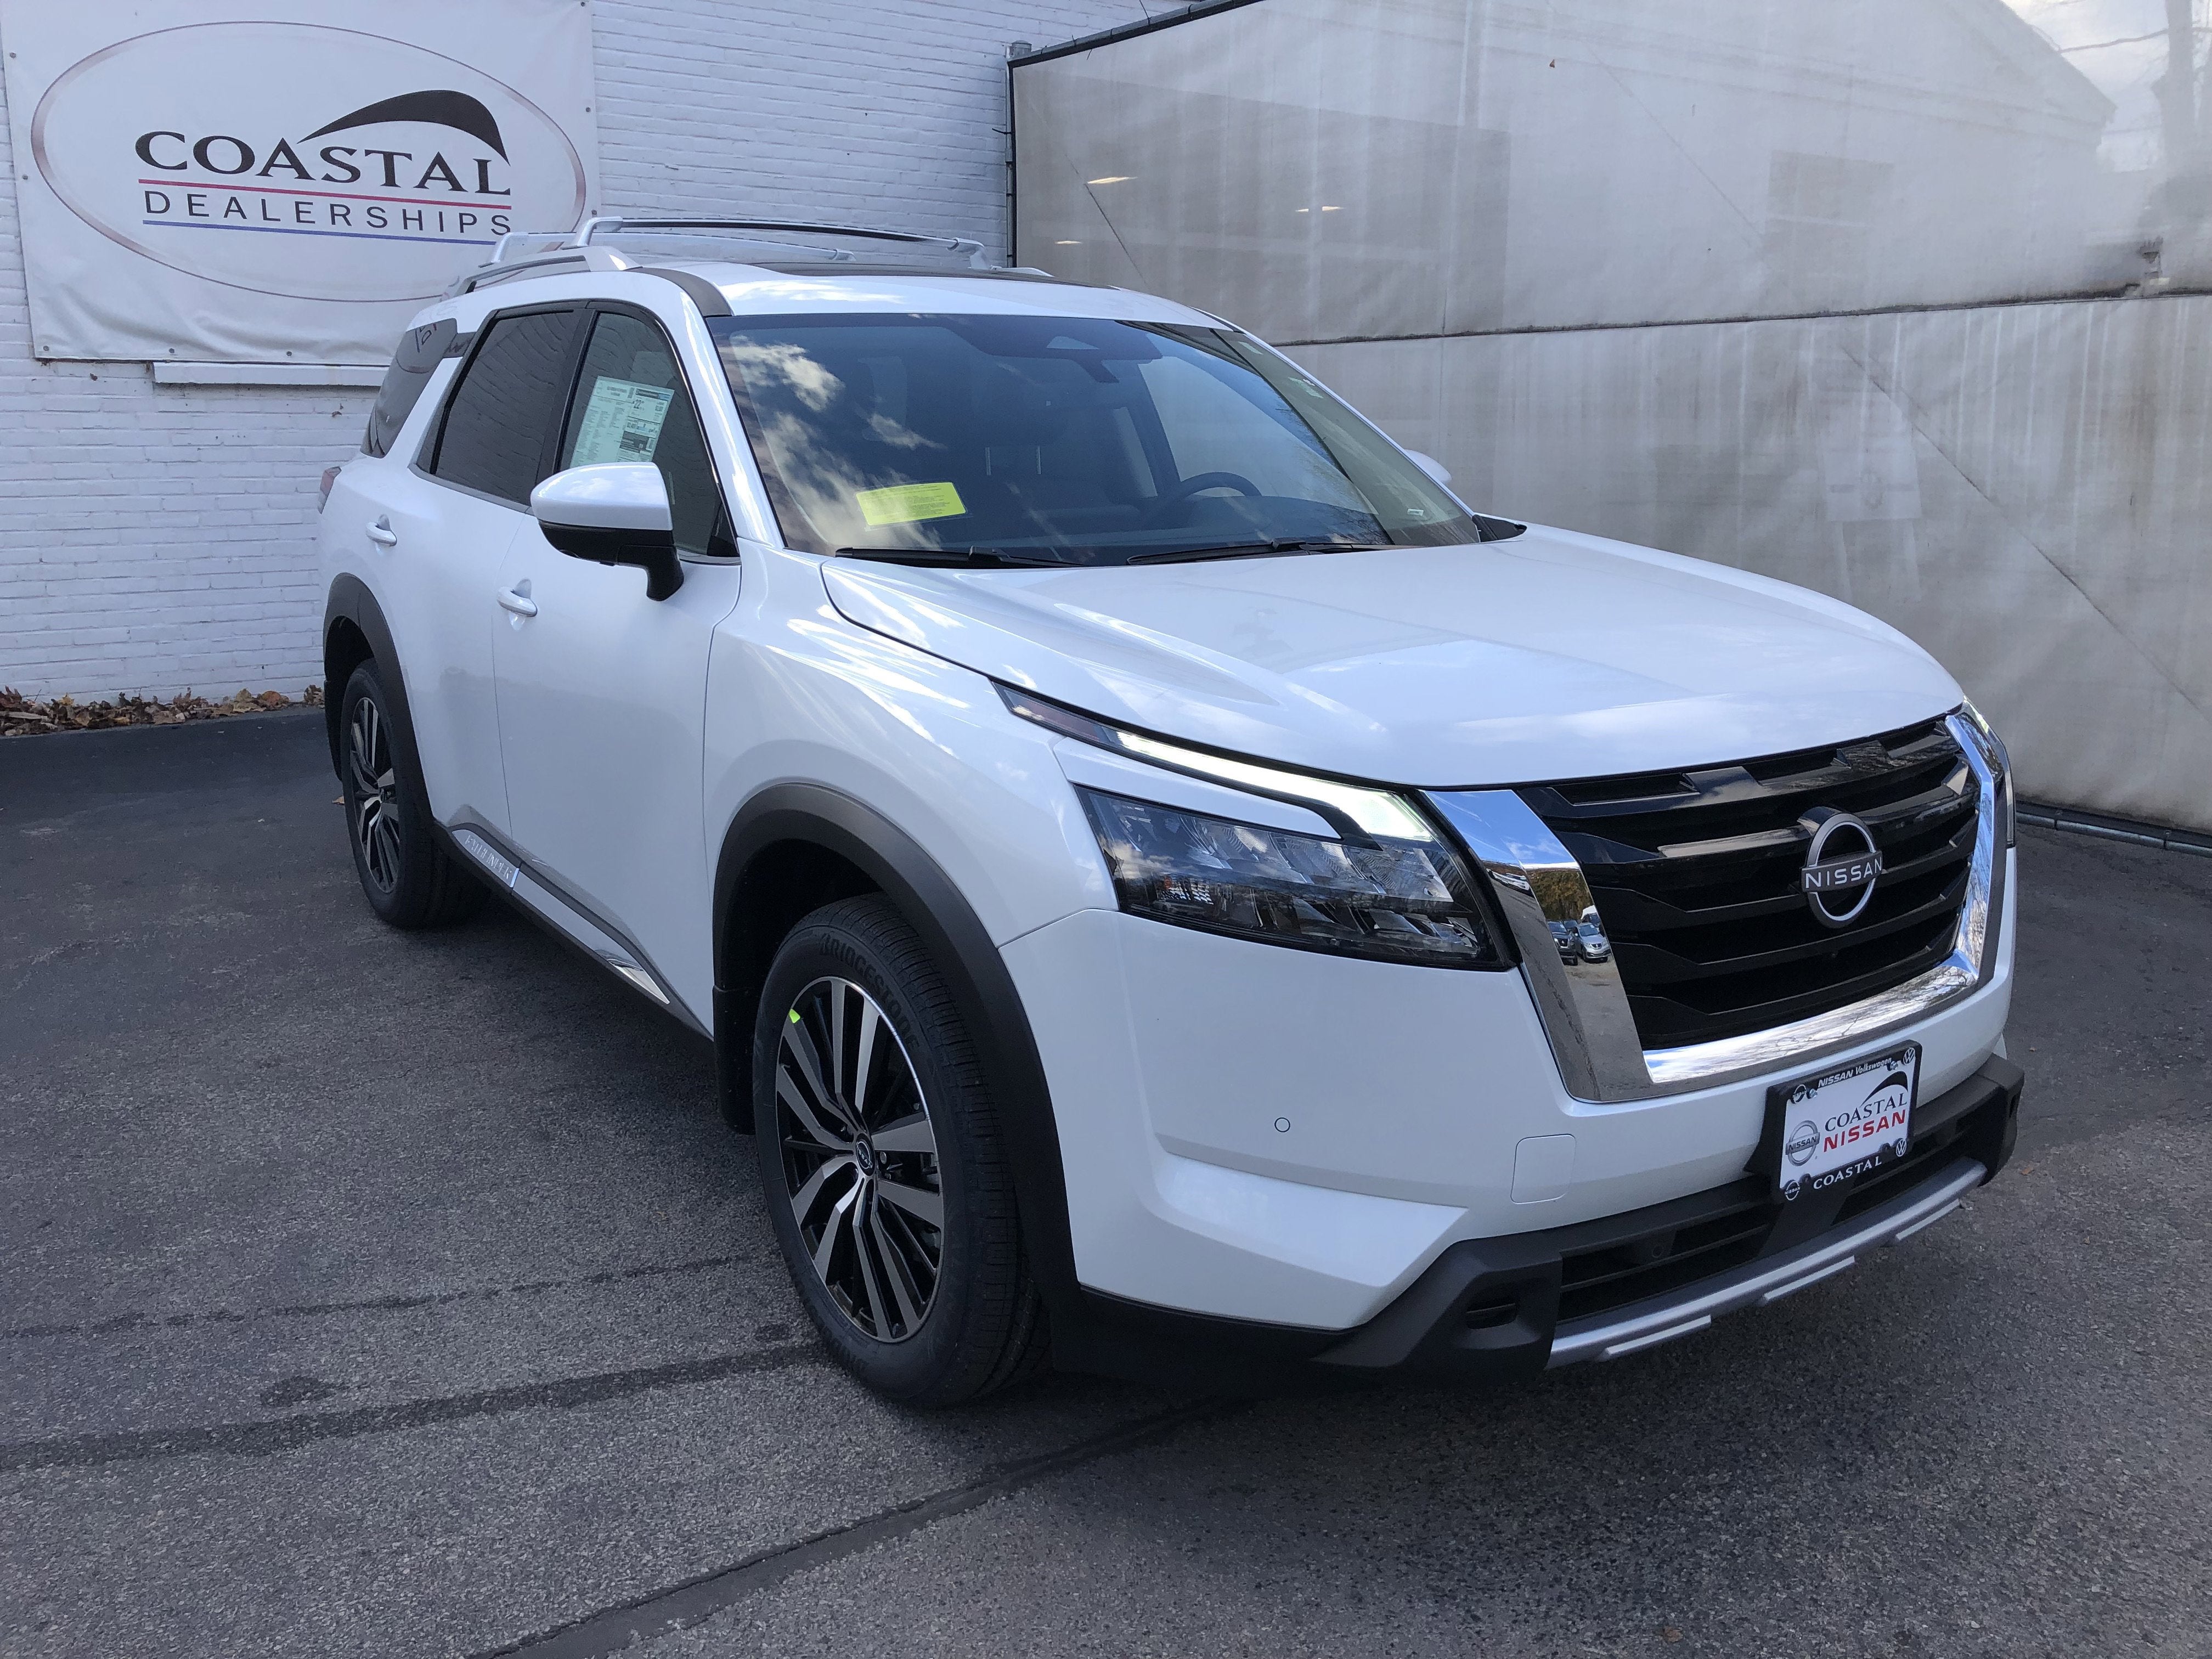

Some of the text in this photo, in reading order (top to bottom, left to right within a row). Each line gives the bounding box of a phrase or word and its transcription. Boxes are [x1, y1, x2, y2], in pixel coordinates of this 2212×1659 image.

[135, 131, 511, 196] COASTAL
[144, 190, 511, 235] DEALERSHIPS
[1805, 856, 1882, 889] NISSAN
[1818, 1058, 1892, 1088] NISSAN Volkswagen
[1825, 1092, 1908, 1132] COASTAL
[1788, 1135, 1817, 1151] NISSAN
[1823, 1109, 1906, 1153] NISSAN
[1813, 1156, 1882, 1190] COASTAL
